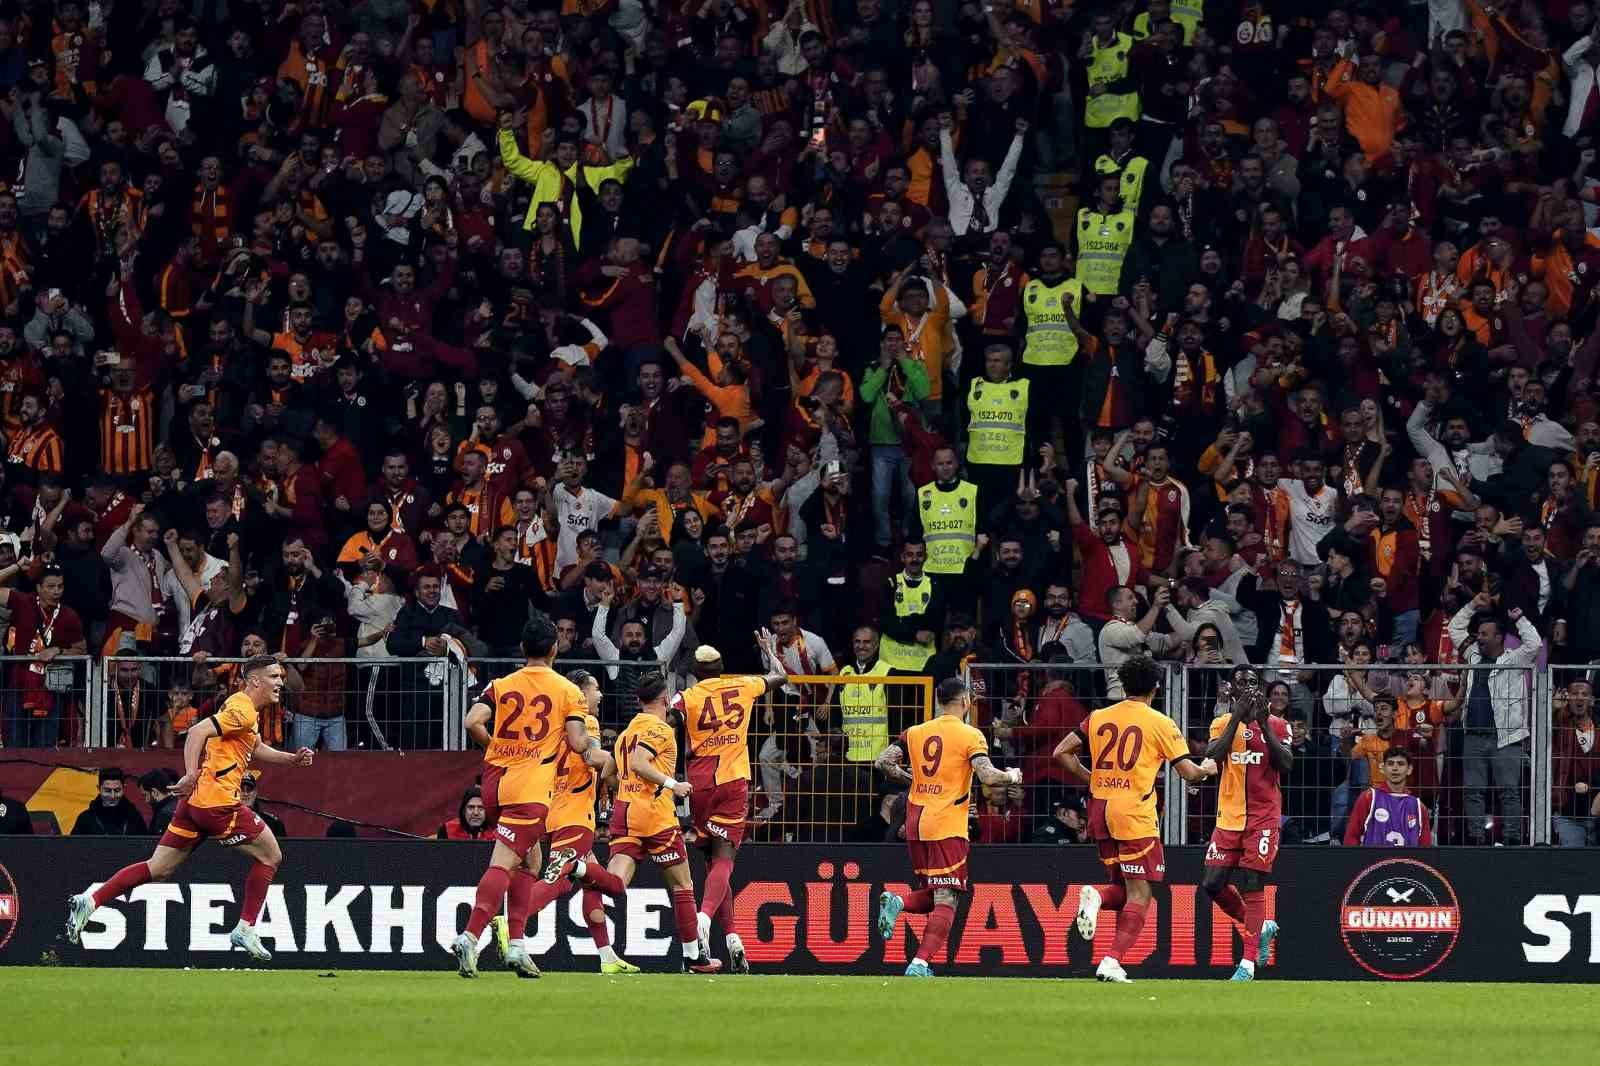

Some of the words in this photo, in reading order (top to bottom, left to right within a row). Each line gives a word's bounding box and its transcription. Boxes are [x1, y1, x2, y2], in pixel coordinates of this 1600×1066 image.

[979, 411, 1013, 421] 1523-070
[929, 520, 963, 530] 1523-027
[497, 691, 553, 741] 23
[698, 689, 745, 733] 45
[921, 735, 943, 777] 9
[1096, 722, 1144, 772] 20
[706, 821, 729, 839] ASHA
[1258, 836, 1270, 856] 6
[933, 877, 961, 886] PASHA
[1348, 907, 1452, 929] GÜNAYDIN
